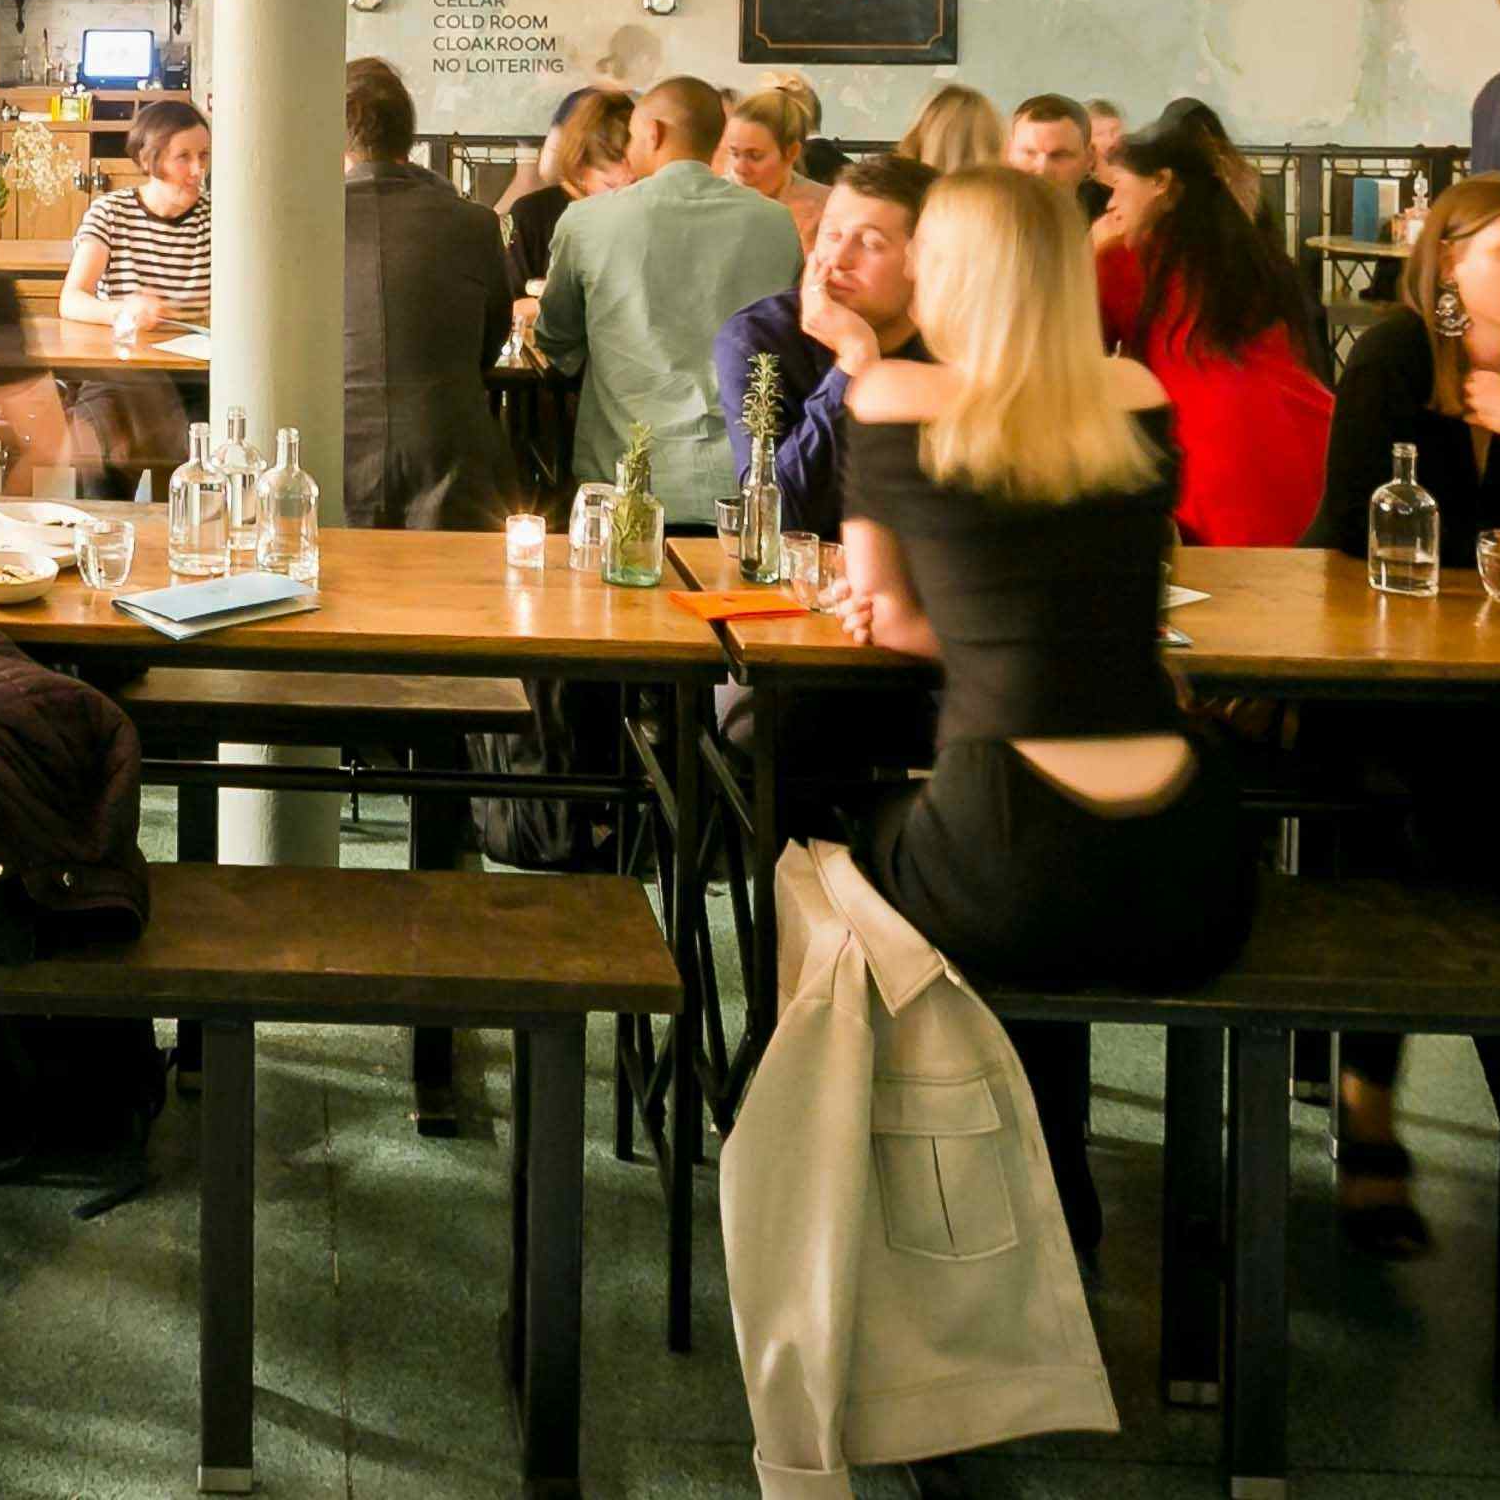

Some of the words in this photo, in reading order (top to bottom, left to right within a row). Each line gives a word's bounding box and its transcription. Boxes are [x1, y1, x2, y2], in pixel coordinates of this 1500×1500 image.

[432, 14, 485, 30] COLD
[489, 14, 549, 30] ROOM
[432, 36, 557, 52] CLOAKROOM
[432, 58, 461, 74] NO
[465, 58, 565, 74] LOITERING
